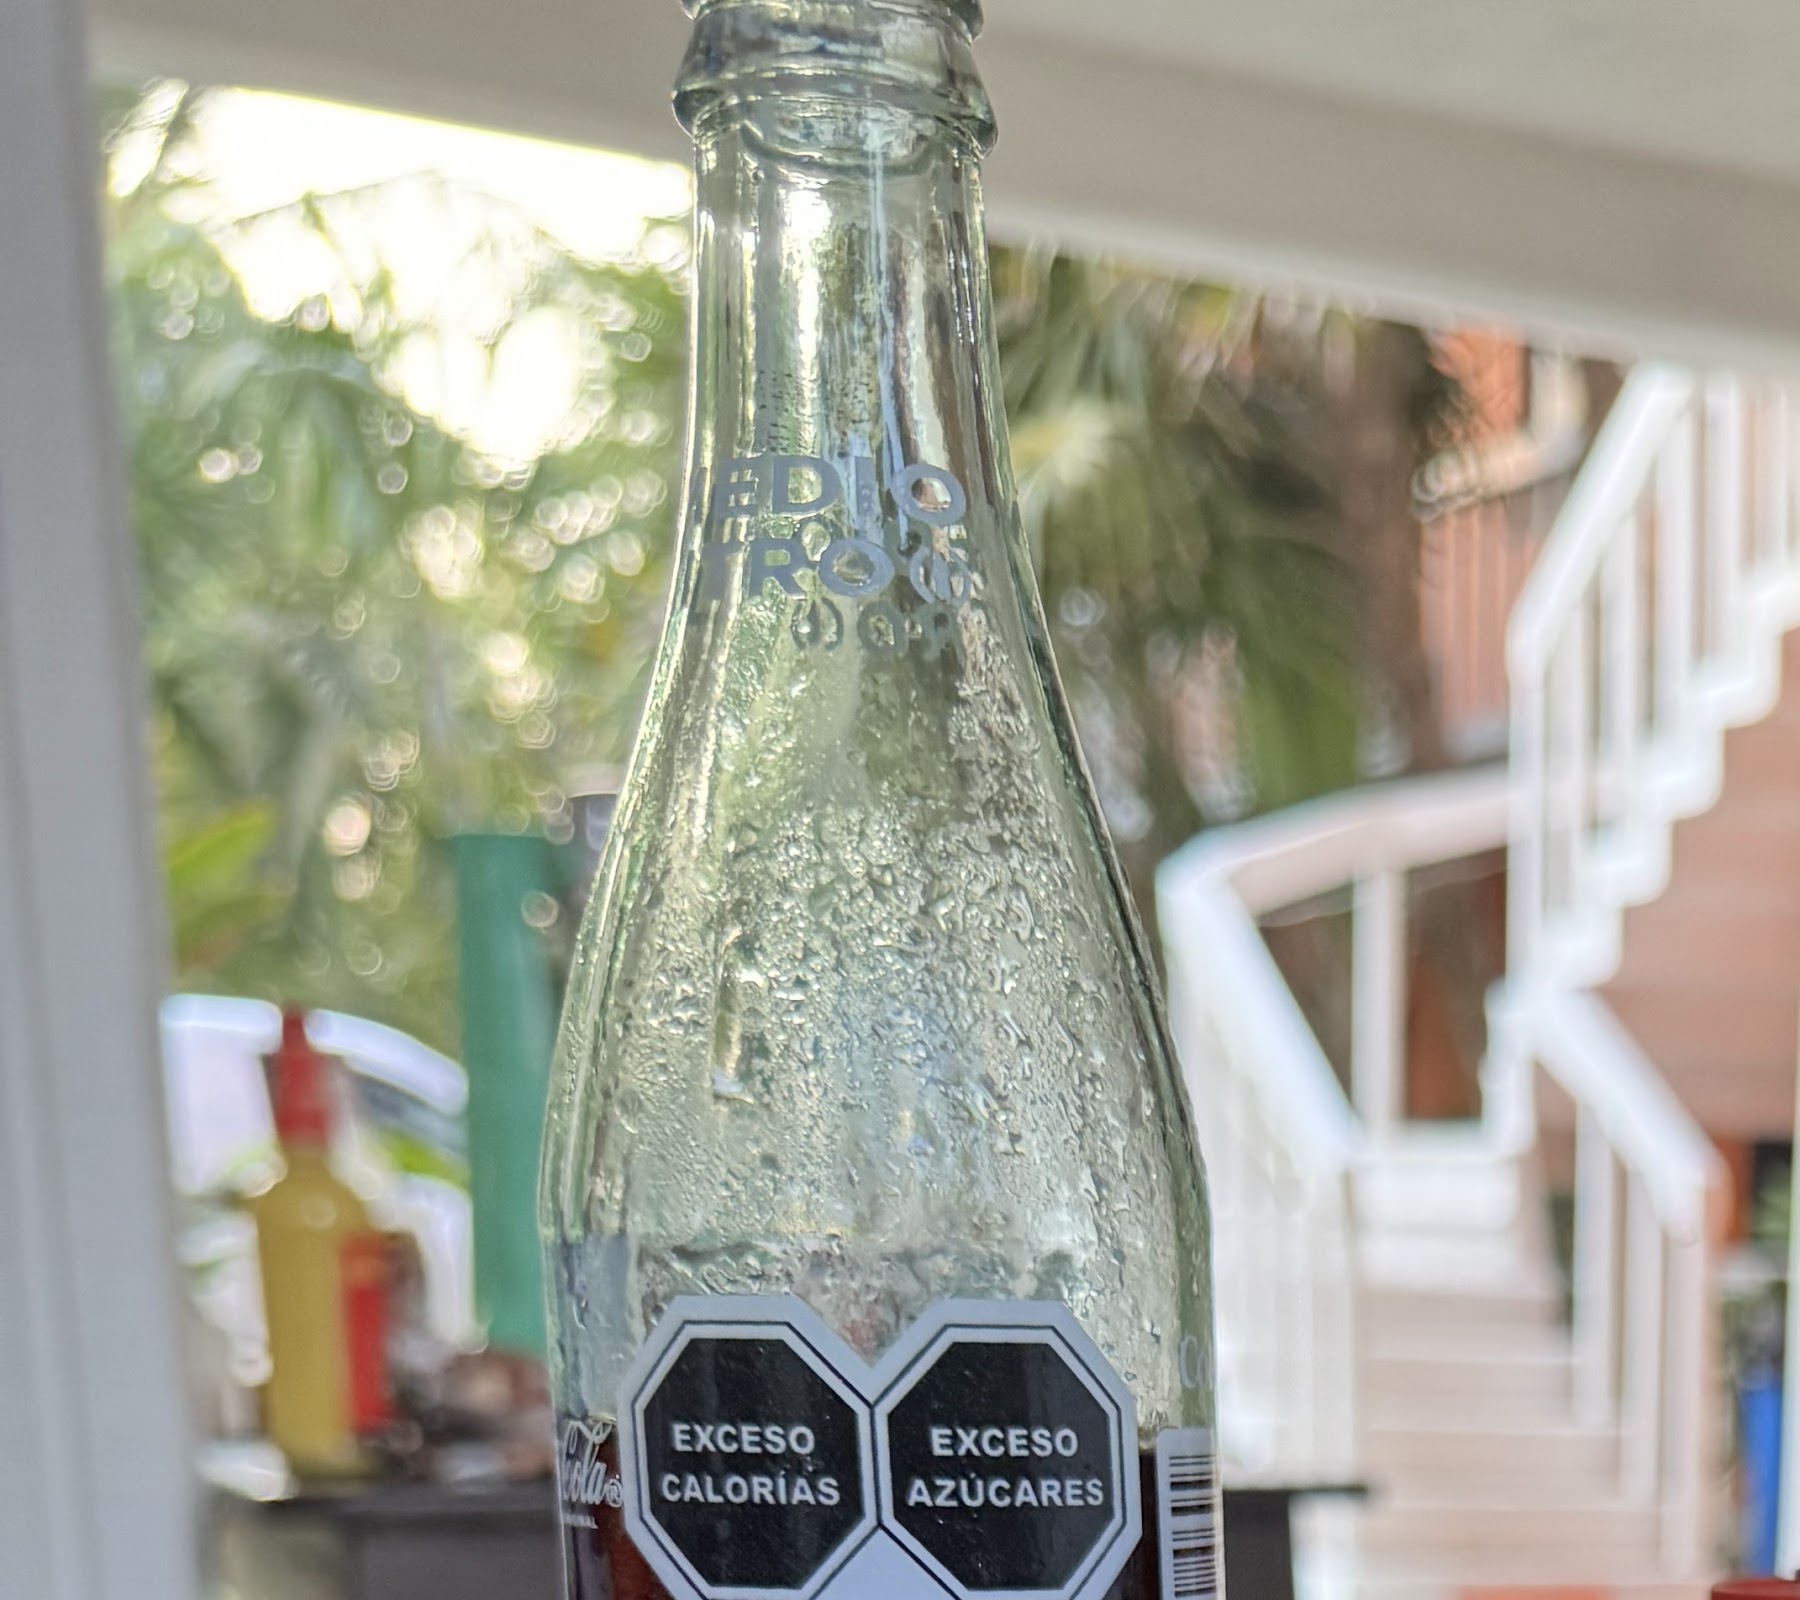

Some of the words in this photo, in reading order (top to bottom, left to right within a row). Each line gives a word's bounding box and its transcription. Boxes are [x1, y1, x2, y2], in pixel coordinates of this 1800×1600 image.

[671, 1423, 816, 1455] EXCESO
[929, 1427, 1079, 1459] EXCESO
[660, 1468, 841, 1506] CALORÍAS
[906, 1471, 1105, 1508] AZÚCARES
